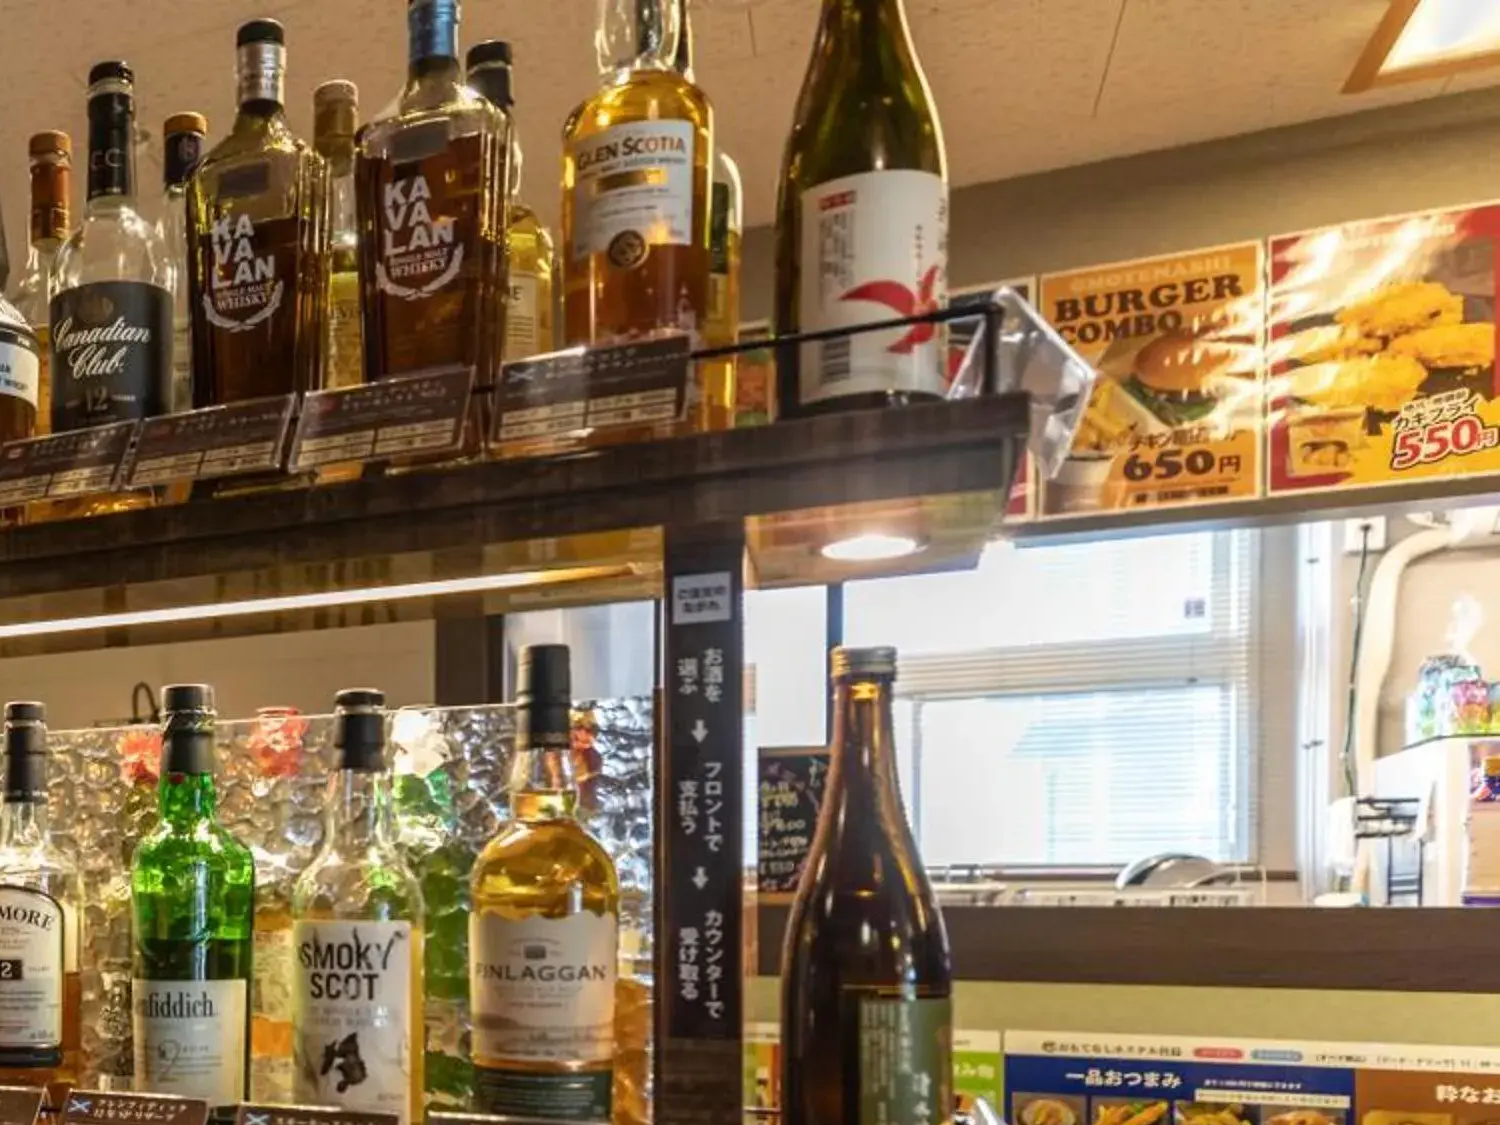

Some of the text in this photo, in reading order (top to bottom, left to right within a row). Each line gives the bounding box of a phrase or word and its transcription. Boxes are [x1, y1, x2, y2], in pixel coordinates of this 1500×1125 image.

[577, 137, 687, 170] GLEN SCOTIA
[385, 176, 431, 206] KA
[211, 213, 255, 242] KA
[385, 202, 431, 231] VA
[212, 238, 255, 264] VA
[385, 220, 455, 254] LAN
[212, 255, 275, 288] LAN
[1054, 273, 1243, 323] BURGER
[53, 315, 151, 353] Canadian
[1058, 310, 1182, 345] COMBO
[677, 780, 699, 835] 支払う
[703, 761, 723, 852] フロントで
[299, 927, 402, 971] SMOKY
[704, 909, 724, 1019] カウンターで
[310, 972, 380, 1001] SCOT
[475, 962, 607, 982] FINLAGGAN
[143, 990, 215, 1019] fiddich
[1064, 1066, 1182, 1090] 一品おつまみ
